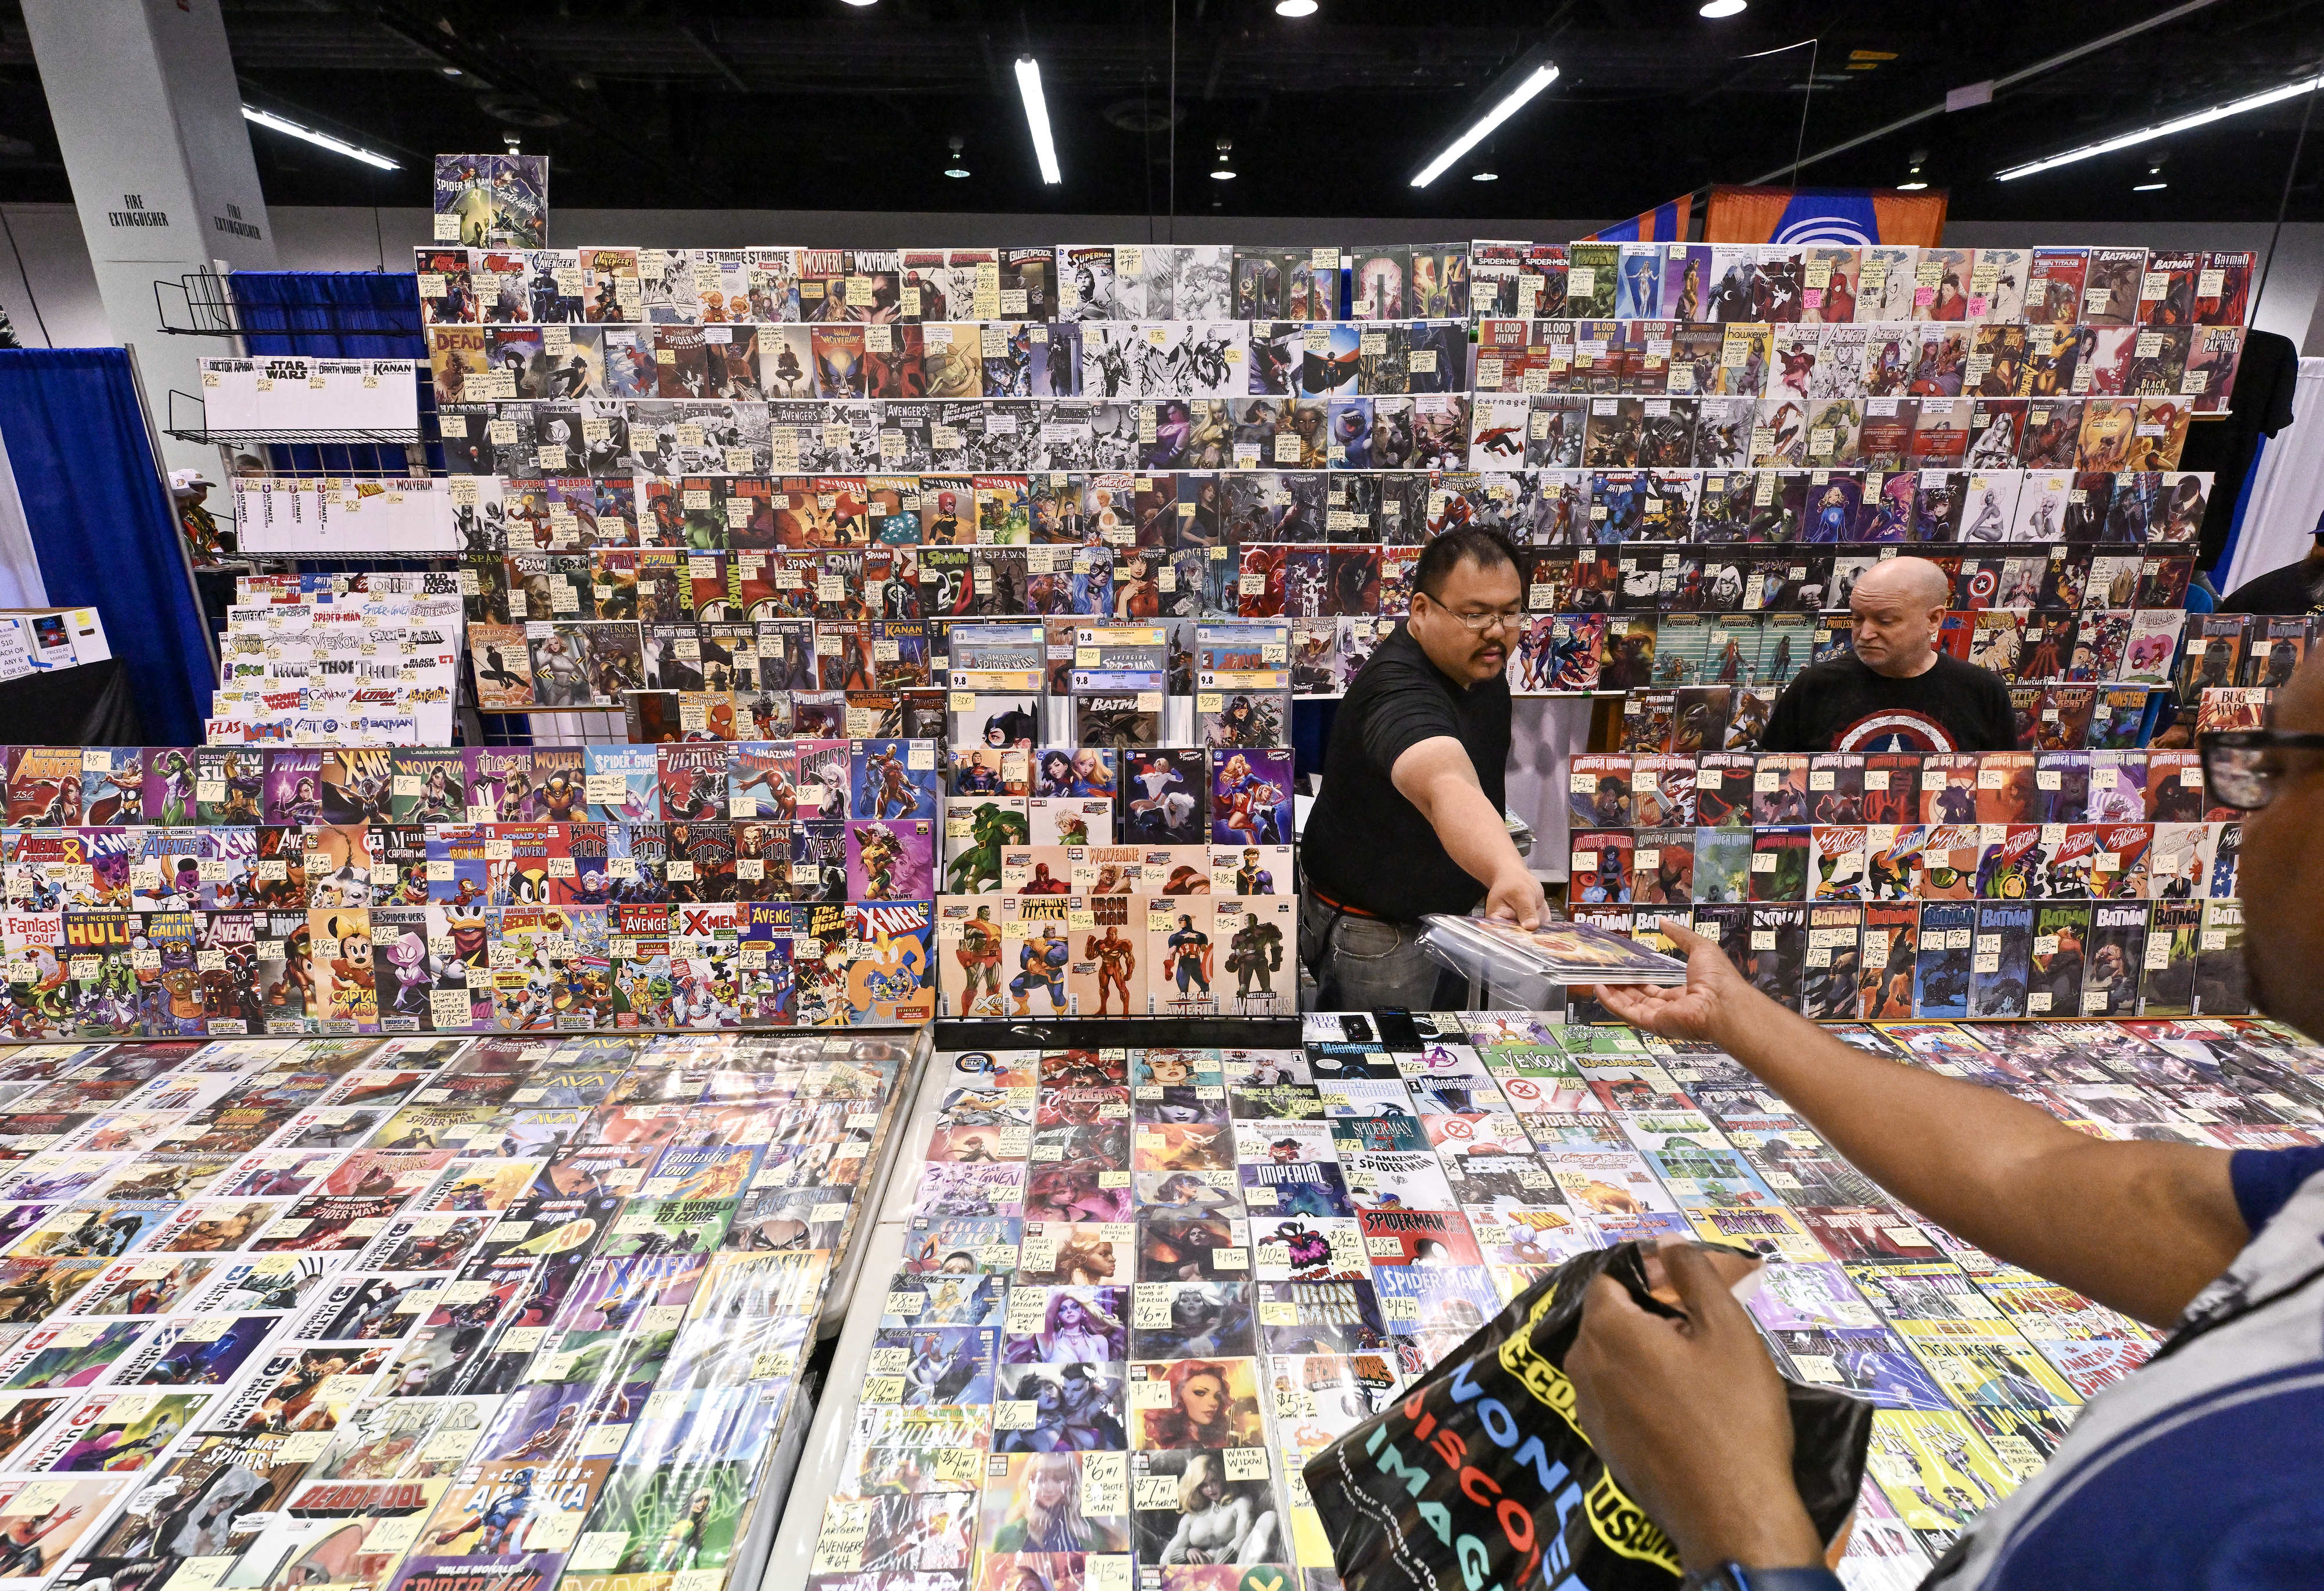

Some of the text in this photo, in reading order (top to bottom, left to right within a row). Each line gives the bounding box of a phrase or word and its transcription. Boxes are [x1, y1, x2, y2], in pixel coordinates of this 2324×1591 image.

[124, 195, 142, 210] FIRE
[227, 205, 241, 220] FIRE
[109, 210, 168, 228] EXTINGUISHER
[214, 216, 261, 241] EXTINGUISHER
[707, 251, 747, 263] STRANGE
[1010, 250, 1053, 261] GWENPOOL
[2100, 250, 2144, 262] BATMAN
[2214, 253, 2248, 264] BATMAN
[536, 257, 575, 274] AVENGERS
[855, 253, 898, 273] WOLVERINE
[2154, 260, 2195, 271] BATMAN
[1494, 323, 1522, 333] BLOOD
[1543, 323, 1570, 334] BLOOD
[1593, 322, 1616, 332] BLOOD
[1644, 323, 1666, 332] BLOOD
[1495, 333, 1519, 344] HUNT
[1594, 331, 1614, 341] HUNT
[1644, 332, 1664, 341] HUNT
[1727, 327, 1767, 339] hawkeye
[2210, 328, 2236, 342] BLACK
[436, 335, 485, 350] DEAD
[1543, 334, 1567, 345] HUNT
[2203, 338, 2239, 354] PANTHER
[234, 362, 253, 372] APHRA
[266, 361, 304, 370] STAR
[319, 365, 361, 374] DARTH VADER
[373, 363, 410, 375] KANAN
[266, 370, 307, 379] WARS
[1477, 398, 1526, 407] carnage
[781, 411, 817, 421] AVENGERS
[832, 406, 869, 423] X-MEN
[887, 406, 927, 417] AVENGERS
[866, 551, 891, 560] SPAWN
[987, 551, 1025, 561] SPAWN
[680, 564, 693, 610] SPAWN
[729, 564, 743, 610] SPAWN
[654, 627, 697, 637] DARTH VADER
[711, 627, 753, 637] DARTH VADER
[885, 625, 922, 637] KANAN
[955, 630, 964, 640] 9.8
[1199, 630, 1208, 640] 9.8
[1081, 632, 1092, 642] 9.8
[987, 652, 1022, 662] AMAZING
[954, 676, 966, 685] 9.8
[1076, 676, 1088, 685] 9.8
[2018, 677, 2049, 686] PUNISHER
[350, 689, 397, 702] ACTION
[409, 689, 448, 703] BATGIRL
[699, 693, 725, 701] AMAZING
[1646, 694, 1674, 704] PREDATOR
[2221, 691, 2246, 703] BUG
[1200, 697, 1220, 707] $275
[370, 718, 413, 729] BATMAN
[755, 748, 796, 758] AMAZING
[1636, 758, 1695, 771] WONDER WOMAN
[1089, 847, 1139, 863] WOLVERINE
[1091, 897, 1128, 911] IRON
[858, 906, 928, 940] X-MEN
[1094, 911, 1128, 926] MAN
[26, 933, 56, 944] FOUR
[1175, 991, 1214, 1001] CAPTAIN
[664, 1149, 730, 1163] Fantastic
[656, 1163, 695, 1178] Four
[654, 1201, 734, 1212] THE WORLD
[654, 1211, 722, 1222] TO COME
[1226, 1449, 1257, 1457] WHITE
[1227, 1457, 1262, 1467] WIDOW
[1338, 1443, 1379, 1507] Visit our
[826, 1555, 849, 1568] #64
